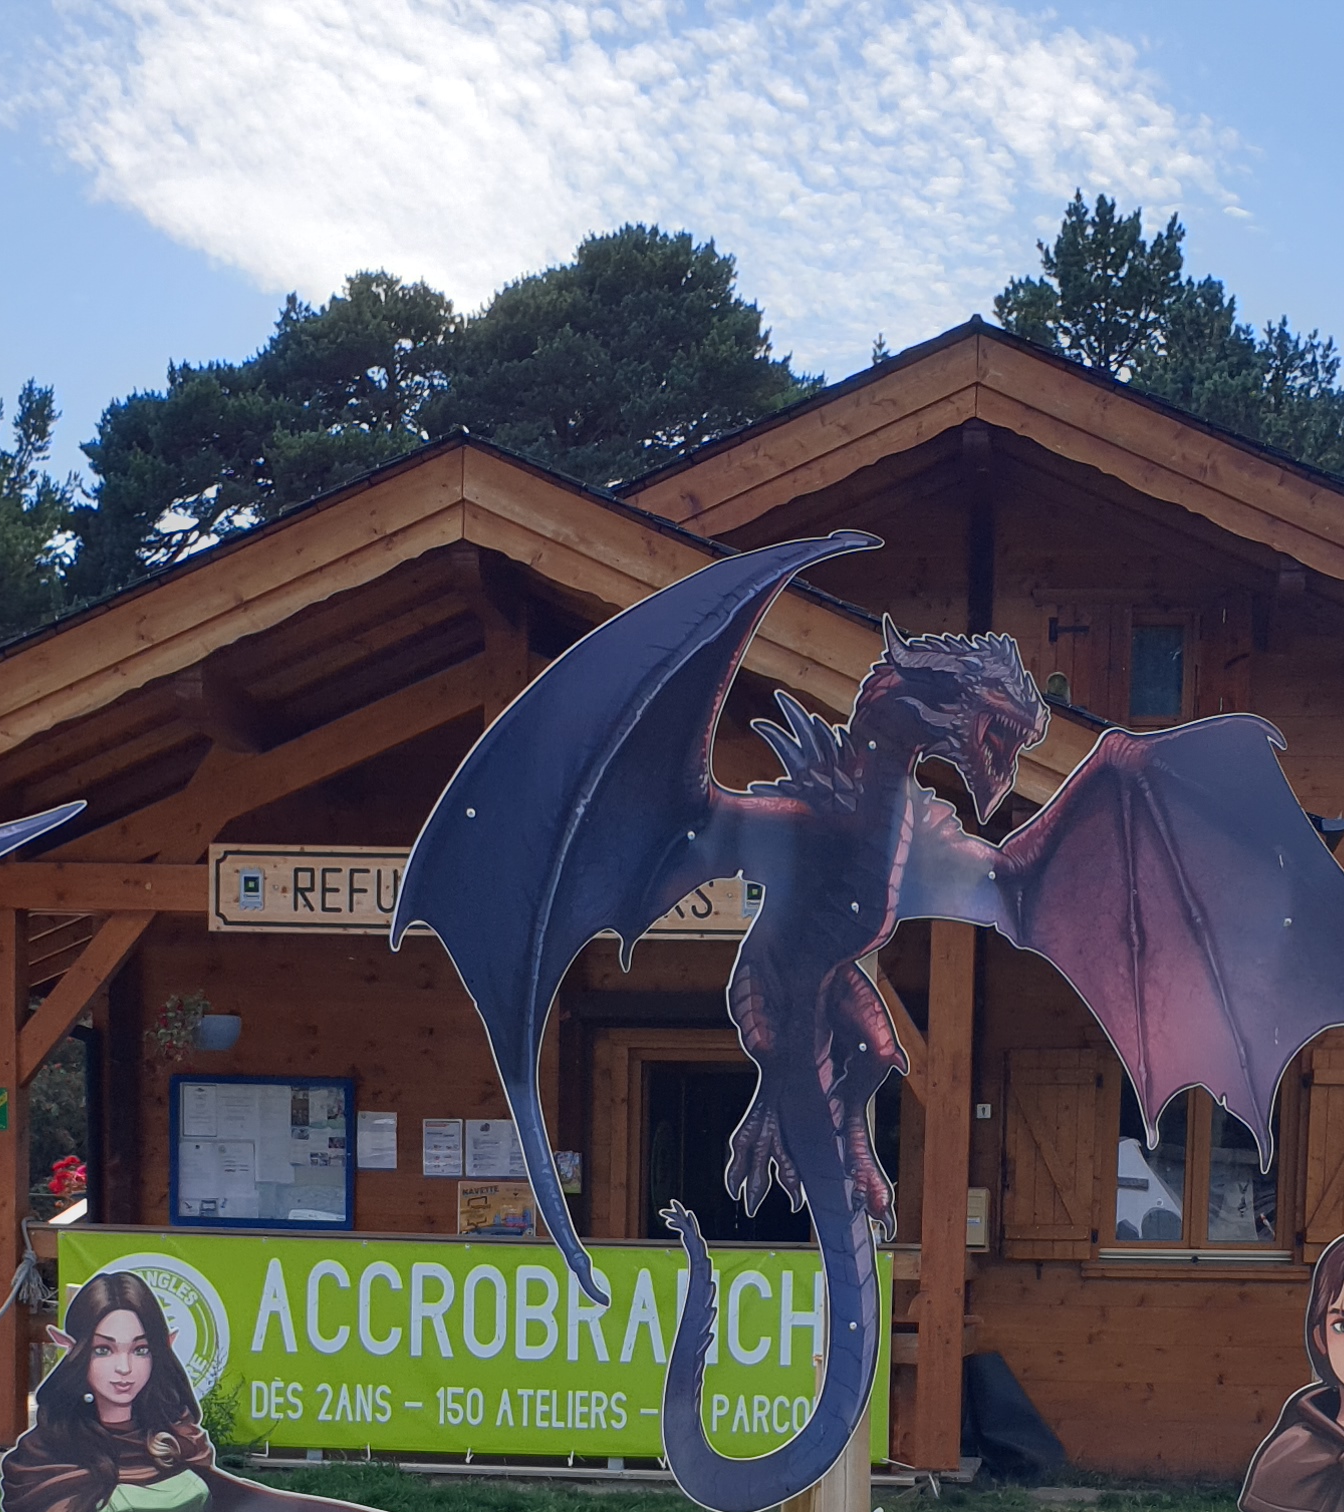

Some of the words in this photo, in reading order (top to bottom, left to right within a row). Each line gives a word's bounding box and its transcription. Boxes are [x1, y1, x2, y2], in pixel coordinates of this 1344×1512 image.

[251, 1377, 304, 1420] DÈS
[316, 1383, 392, 1423] 2ANS
[436, 1387, 484, 1426] 150
[496, 1389, 628, 1430] ATELIERS
